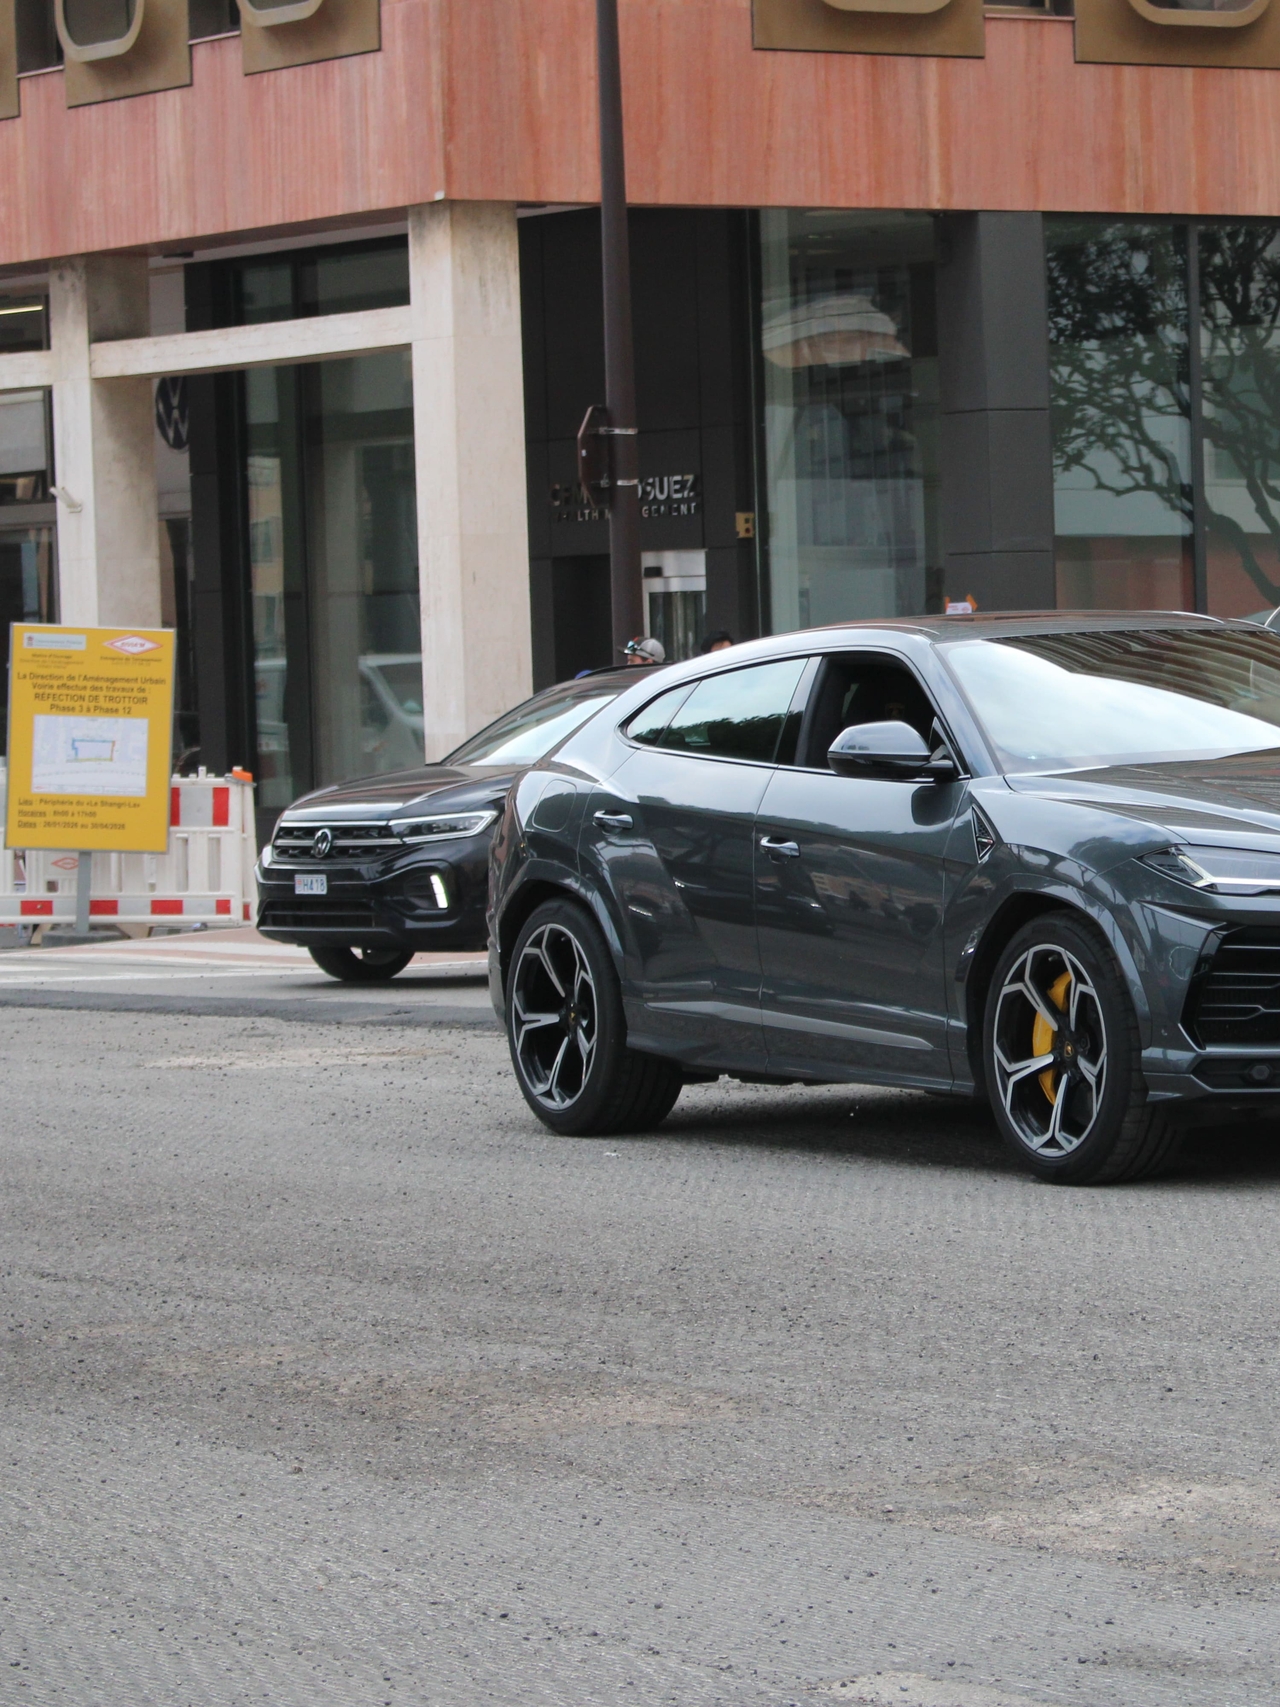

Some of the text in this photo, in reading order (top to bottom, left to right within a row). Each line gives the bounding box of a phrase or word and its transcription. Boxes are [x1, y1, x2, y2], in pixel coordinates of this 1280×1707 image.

[604, 502, 697, 520] MGEMENT
[17, 672, 27, 680] La
[29, 672, 64, 681] Direction
[66, 673, 76, 681] de
[140, 676, 166, 685] Urbain
[32, 681, 54, 690] Voirie
[57, 682, 87, 691] effectue
[89, 683, 103, 692] des
[105, 685, 134, 693] travaux
[34, 691, 148, 705] RÉFECTION DE TROTTOIR
[50, 704, 77, 713] Phase
[93, 705, 120, 714] Phase
[122, 706, 132, 714] 12
[75, 799, 84, 807] du
